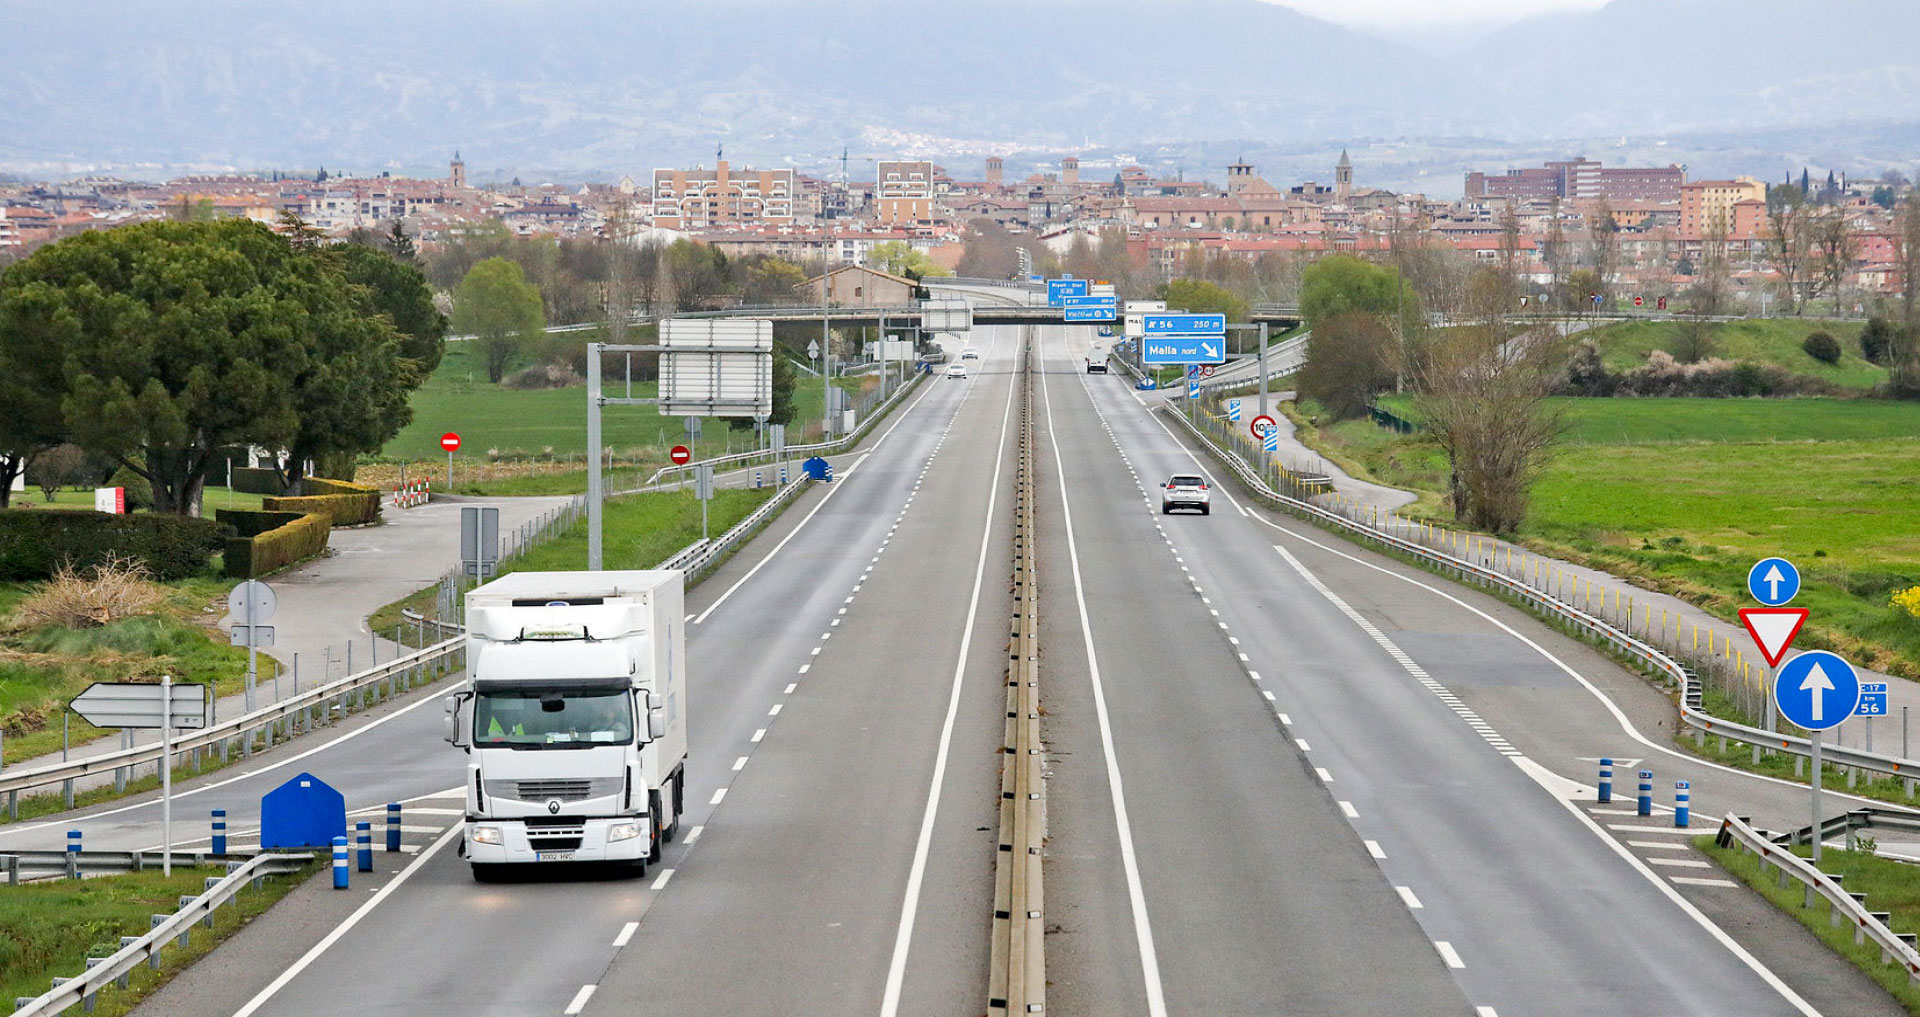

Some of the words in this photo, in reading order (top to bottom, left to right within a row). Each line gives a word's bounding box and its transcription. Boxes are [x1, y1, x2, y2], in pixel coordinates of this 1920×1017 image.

[1159, 320, 1173, 328] 56
[1193, 320, 1210, 328] 250
[1149, 345, 1177, 355] Malla
[1181, 347, 1197, 355] nord
[1860, 703, 1880, 713] 56
